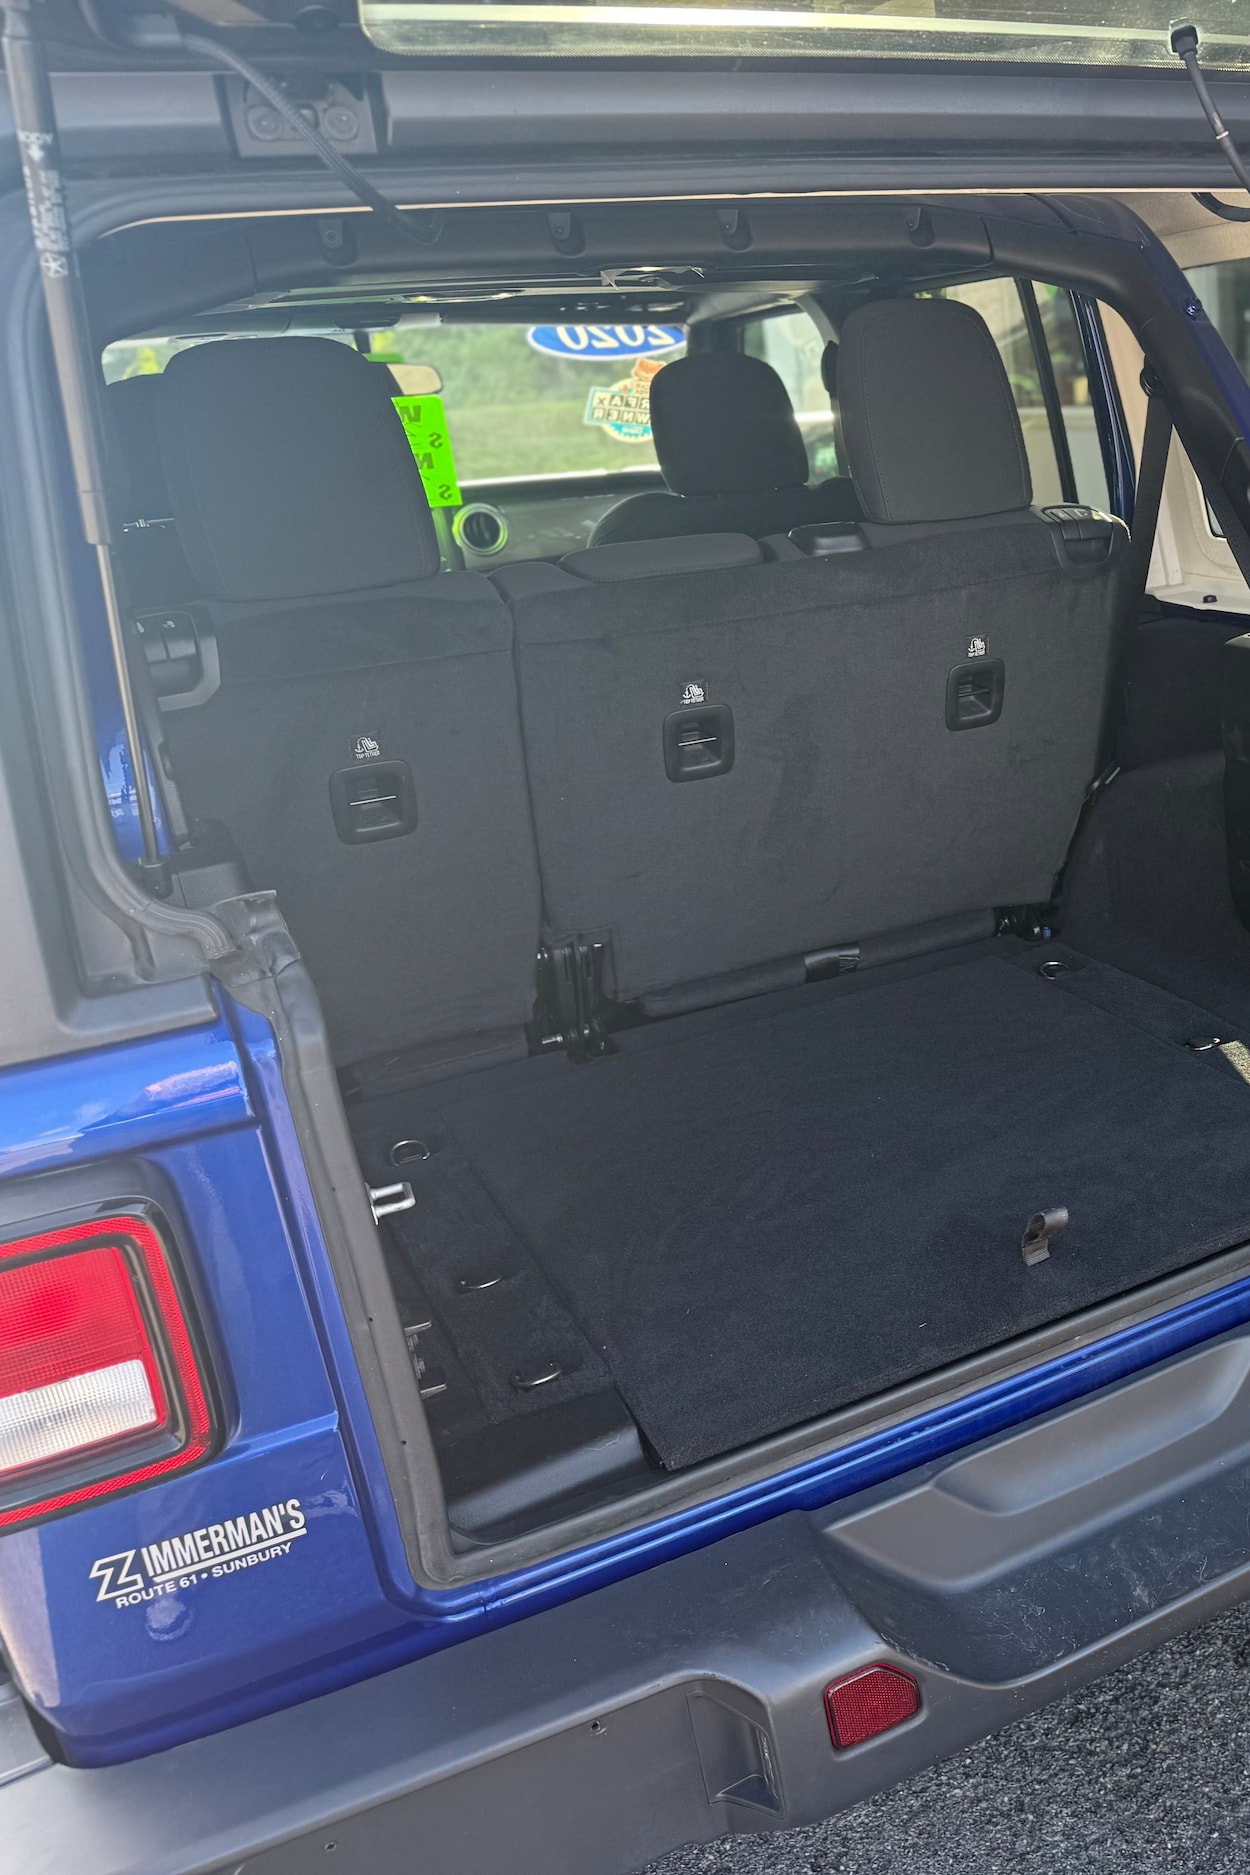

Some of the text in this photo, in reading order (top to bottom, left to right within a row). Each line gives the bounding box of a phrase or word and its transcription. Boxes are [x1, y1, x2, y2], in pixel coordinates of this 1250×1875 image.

[89, 1498, 306, 1602] ZIMMERMAN'S
[116, 1541, 293, 1609] ROUTE 61 SUNBURY
